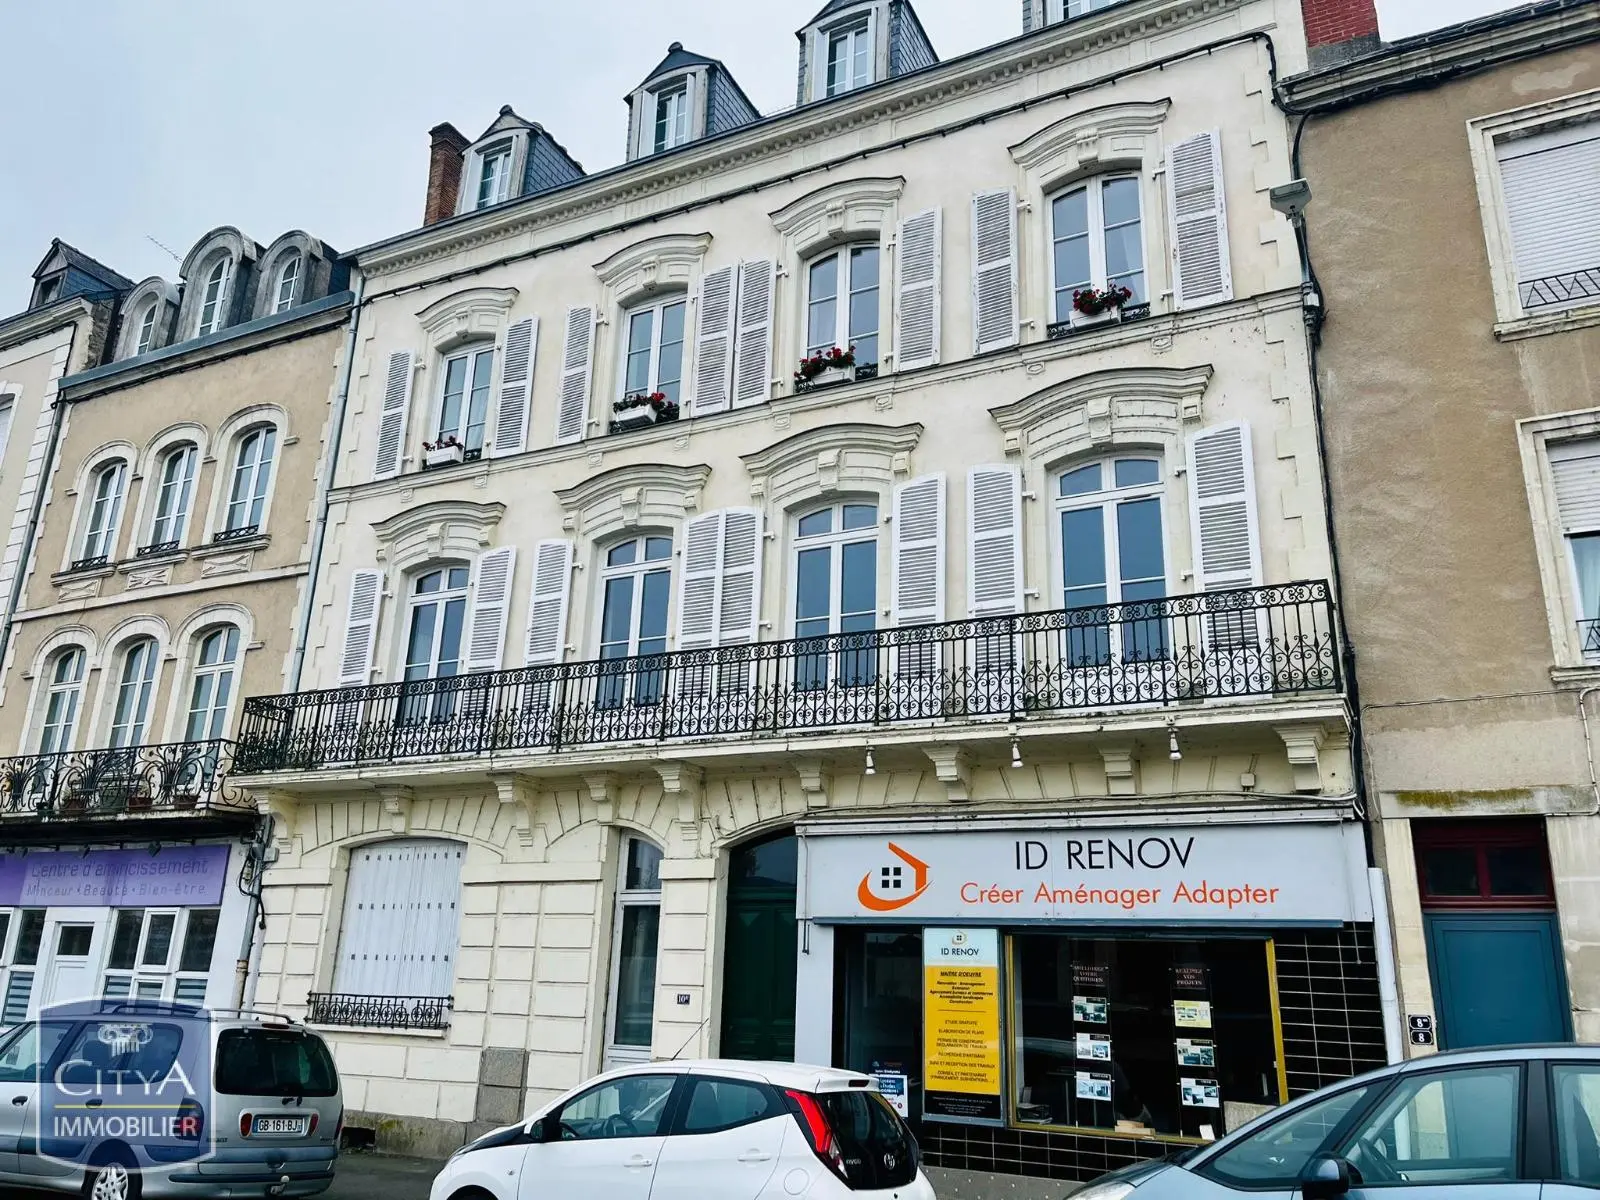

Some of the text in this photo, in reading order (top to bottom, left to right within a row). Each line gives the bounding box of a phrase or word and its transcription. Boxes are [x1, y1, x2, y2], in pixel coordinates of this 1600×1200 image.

[1015, 837, 1194, 870] ID RENOV
[32, 859, 209, 878] Centre d'amincissement
[960, 880, 1279, 909] Créer Aménager Adapter
[941, 948, 979, 956] ID RENOV
[1418, 1032, 1425, 1042] 8
[258, 1120, 298, 1131] GB-161-BJ
